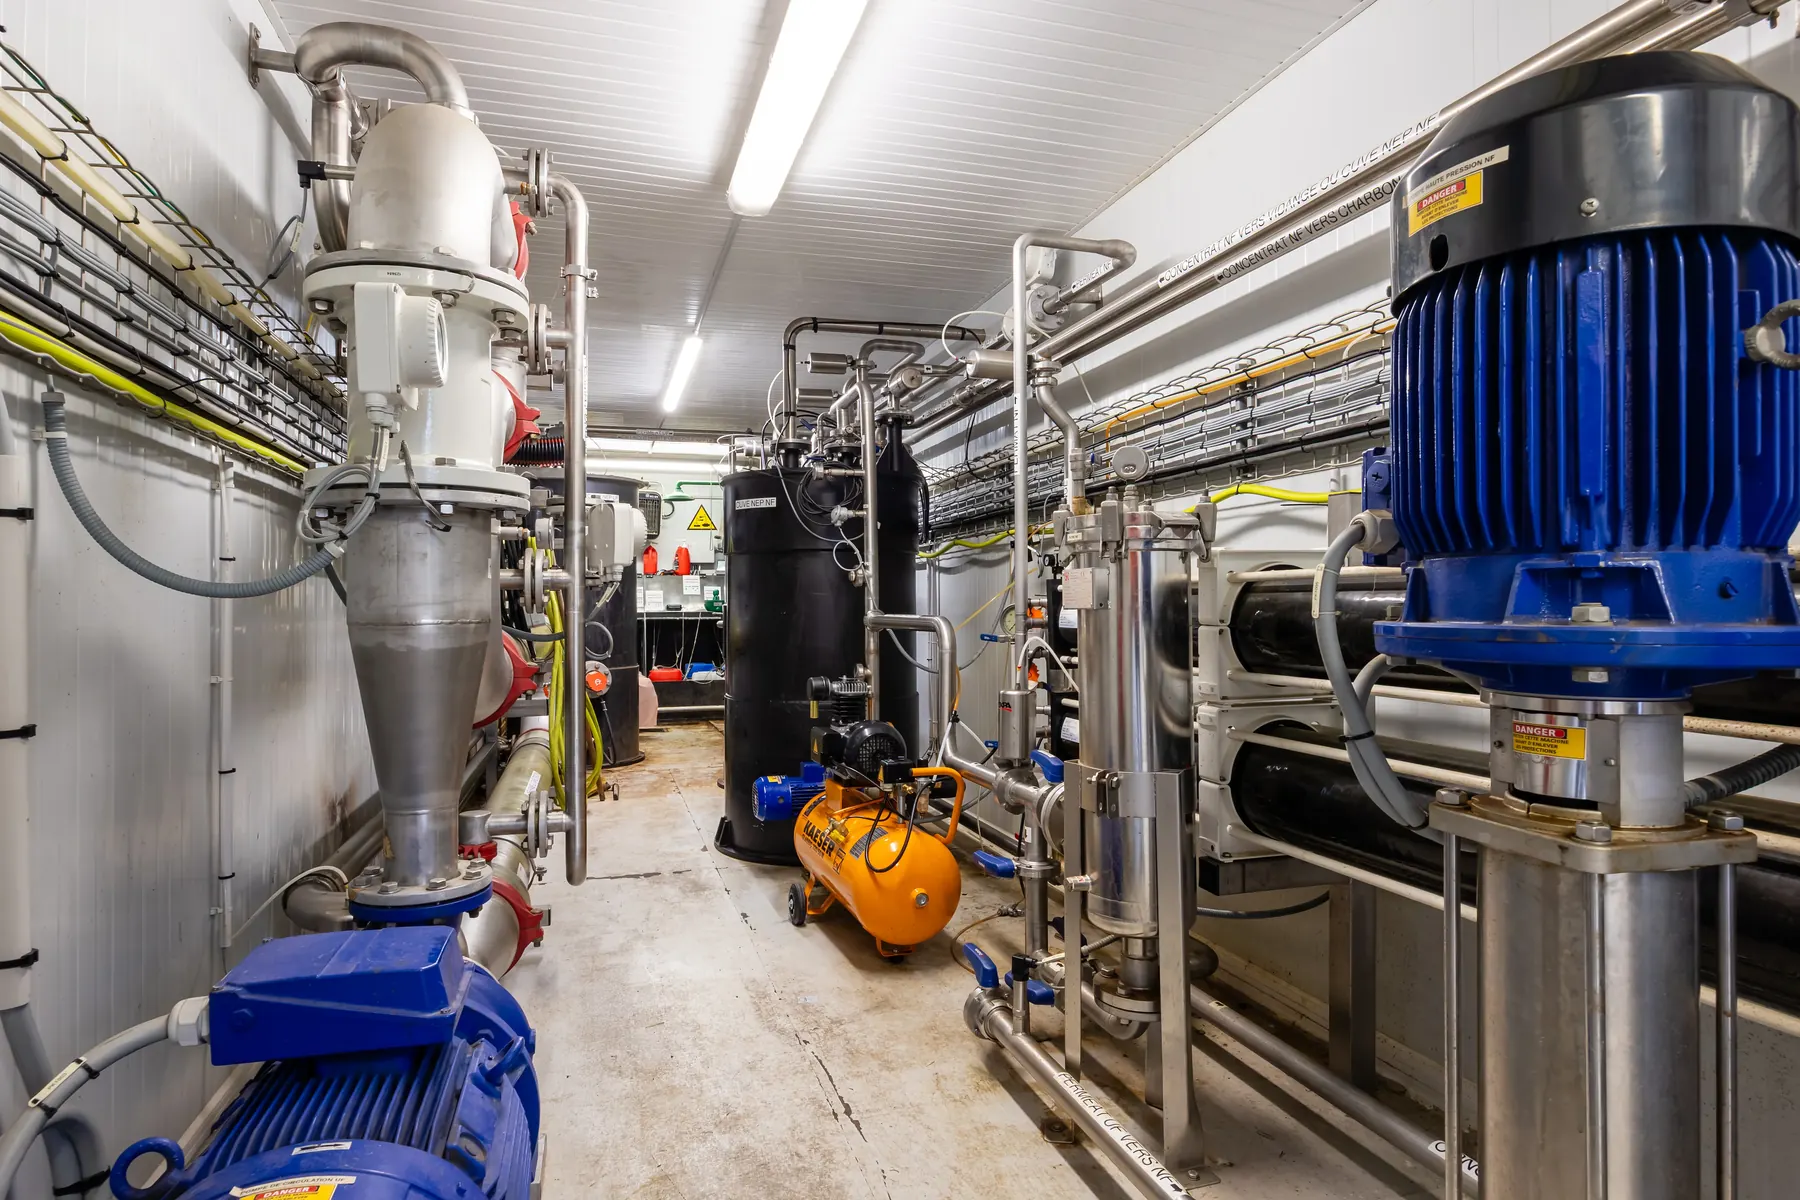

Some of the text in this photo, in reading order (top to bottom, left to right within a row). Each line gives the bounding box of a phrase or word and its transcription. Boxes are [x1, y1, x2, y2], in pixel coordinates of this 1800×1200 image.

[1426, 176, 1445, 190] HAUTE
[1446, 160, 1483, 178] PRESSION
[1484, 154, 1495, 164] NF
[1164, 112, 1438, 282] CONCENTRAT NF VERS VIDANGE OU CUVE NEP NF
[1422, 184, 1457, 208] DANGER
[1222, 236, 1288, 279] CONCENTRAT
[1288, 227, 1303, 245] NF
[1304, 210, 1338, 235] VERS
[750, 499, 765, 507] NEP
[765, 498, 776, 506] NF
[1515, 724, 1556, 738] DANGER
[1521, 745, 1557, 755] PROTECTIONS
[1539, 737, 1569, 745] MACHINE
[803, 820, 836, 858] KAESER
[1058, 1072, 1174, 1184] PERMEAT UF VERS NF
[282, 1176, 333, 1187] CIRCULATION
[264, 1187, 310, 1198] DANGER
